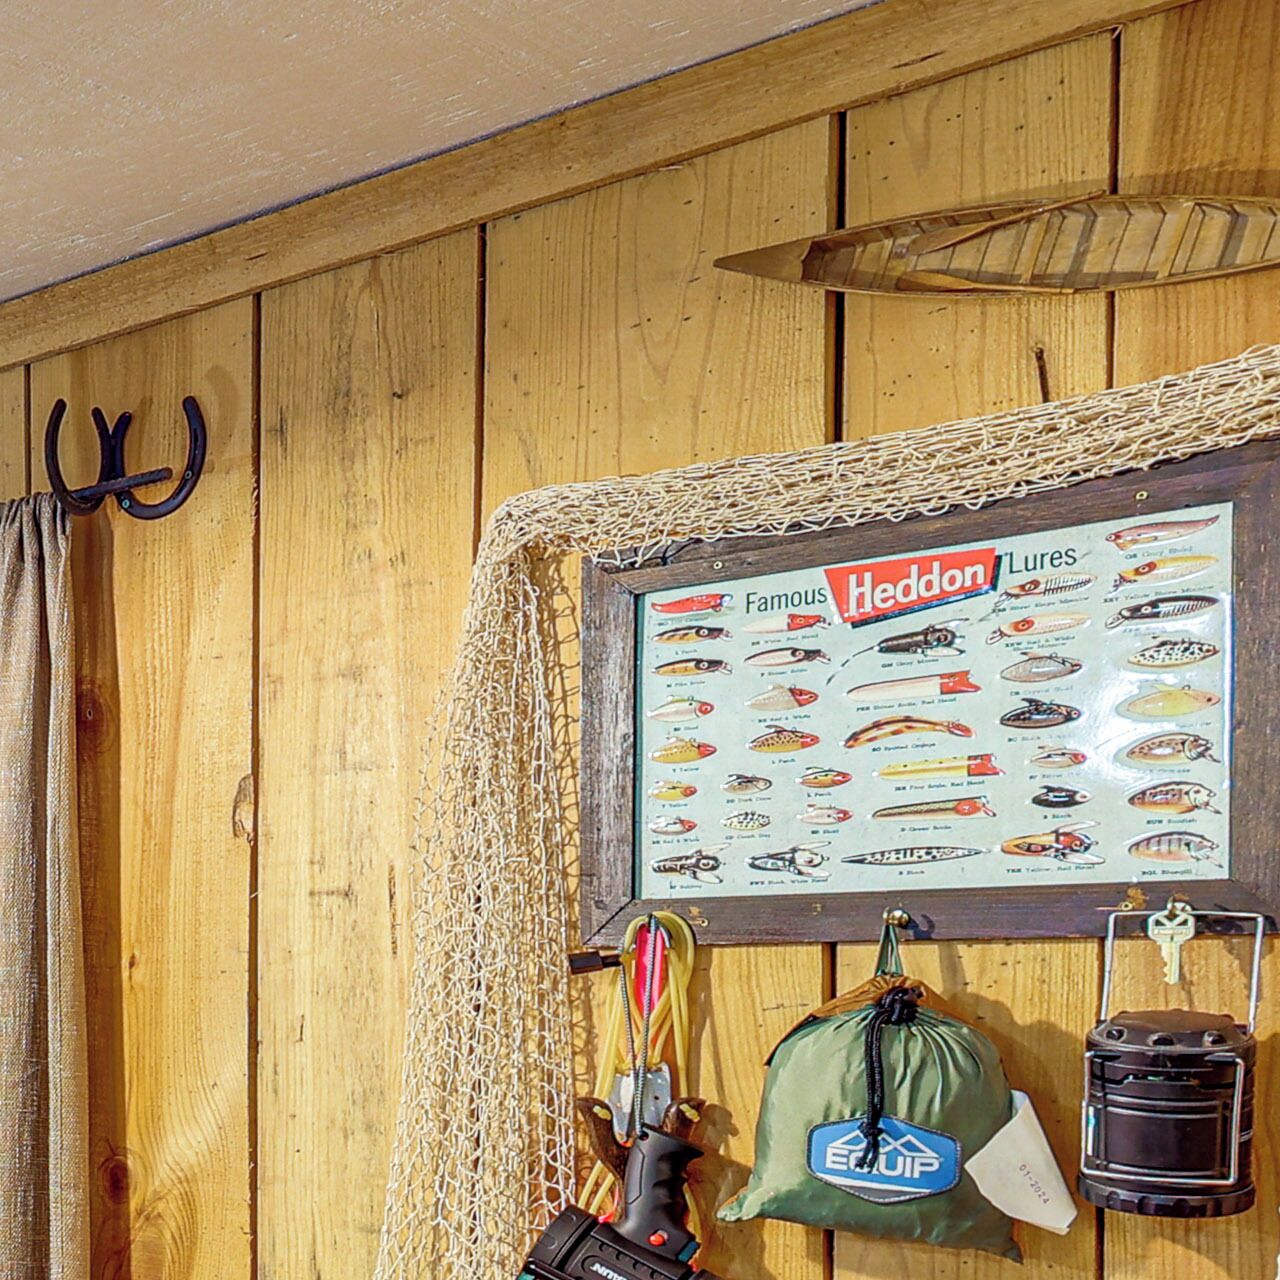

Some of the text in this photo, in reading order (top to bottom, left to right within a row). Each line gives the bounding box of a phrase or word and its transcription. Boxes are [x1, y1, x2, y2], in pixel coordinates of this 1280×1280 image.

[745, 586, 828, 614] Famous
[847, 560, 985, 617] Heddon
[1007, 547, 1078, 575] Lures
[1019, 1163, 1050, 1204] 01-2024
